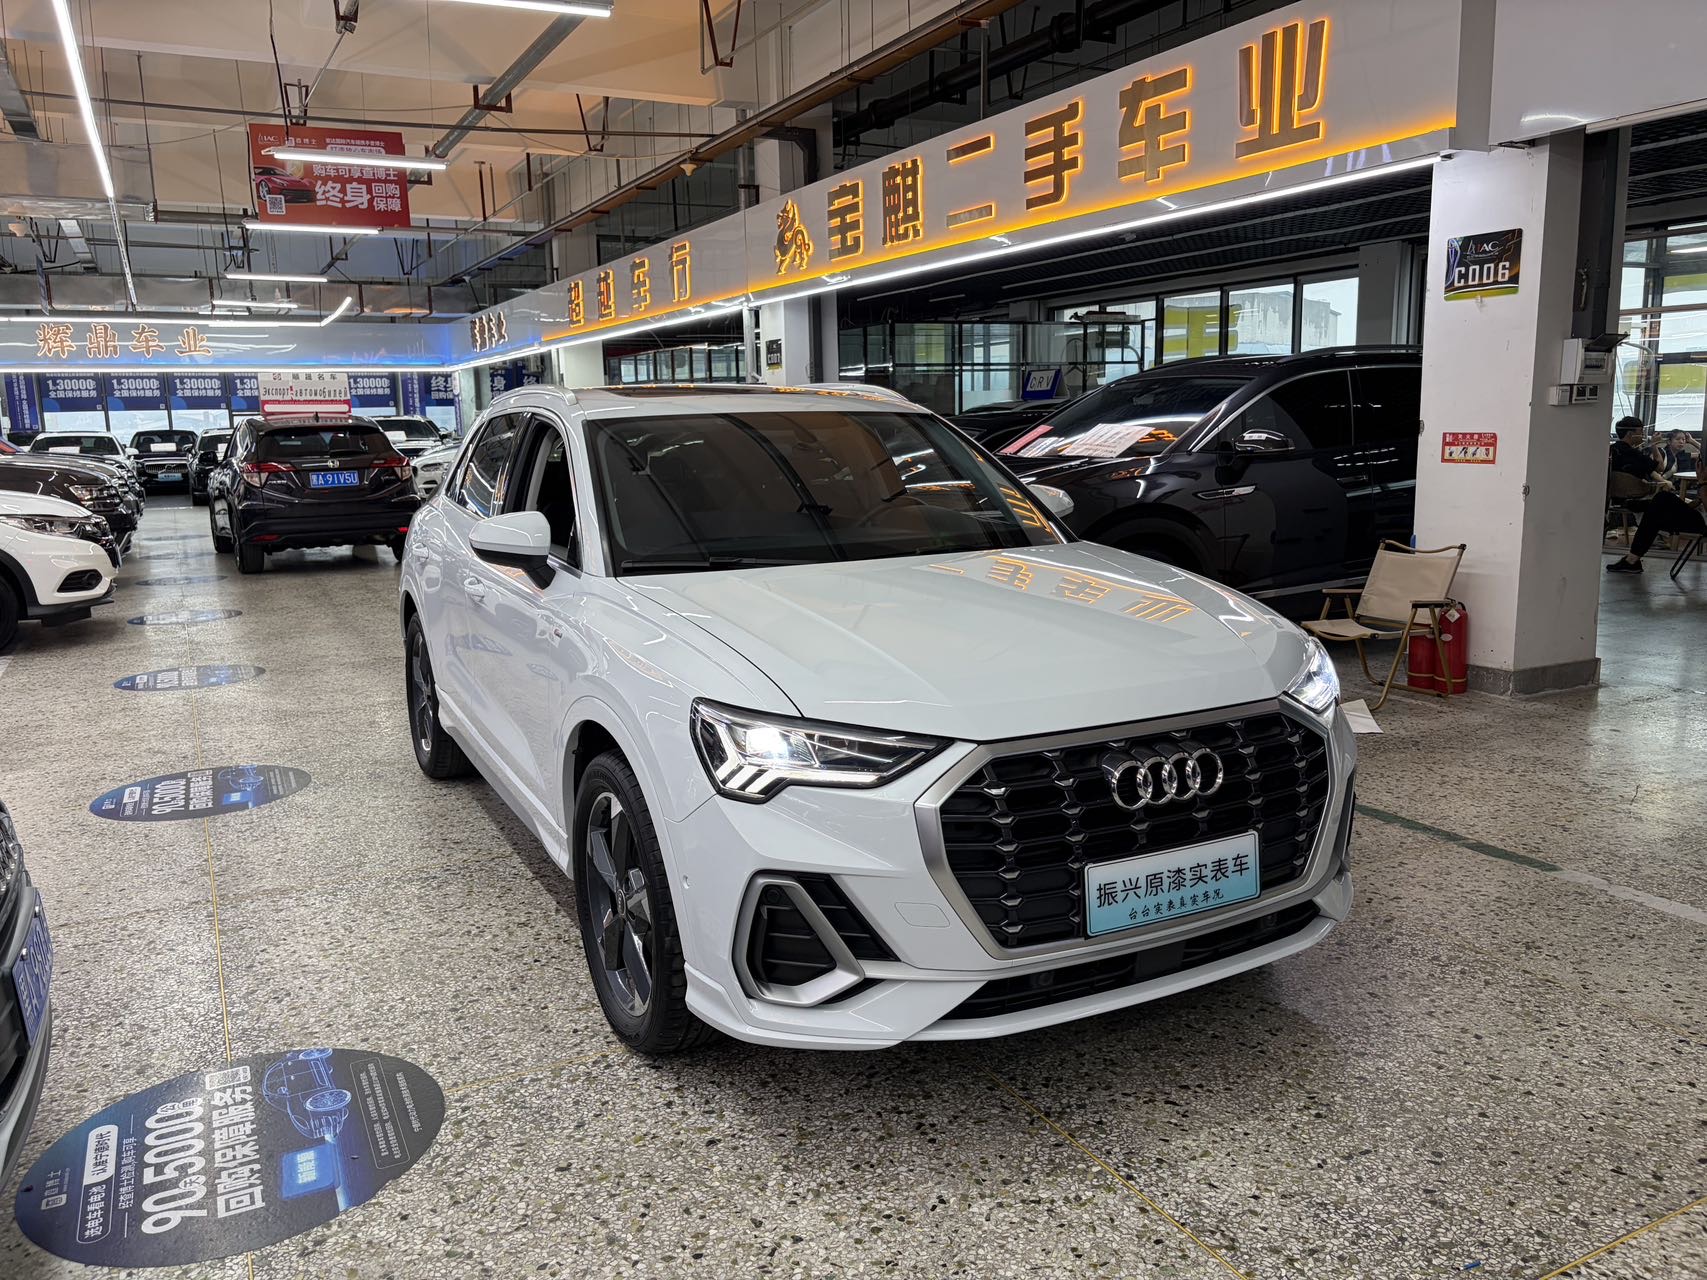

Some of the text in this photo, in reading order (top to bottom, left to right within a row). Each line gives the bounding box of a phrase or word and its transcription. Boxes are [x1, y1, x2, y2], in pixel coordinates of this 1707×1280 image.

[826, 18, 1330, 263] 宝麒二手车业
[313, 164, 398, 180] 购车可享查博士
[372, 183, 400, 197] 回购
[315, 181, 371, 209] 终身
[373, 197, 402, 212] 保障
[1453, 261, 1510, 287] C006
[35, 322, 214, 359] 辉鼎车业
[1096, 853, 1250, 909] 振兴原漆实表车
[91, 1130, 112, 1177] 认准宁德时代
[209, 1085, 266, 1219] 回购保障服务
[84, 1184, 107, 1239] 选电车看电池
